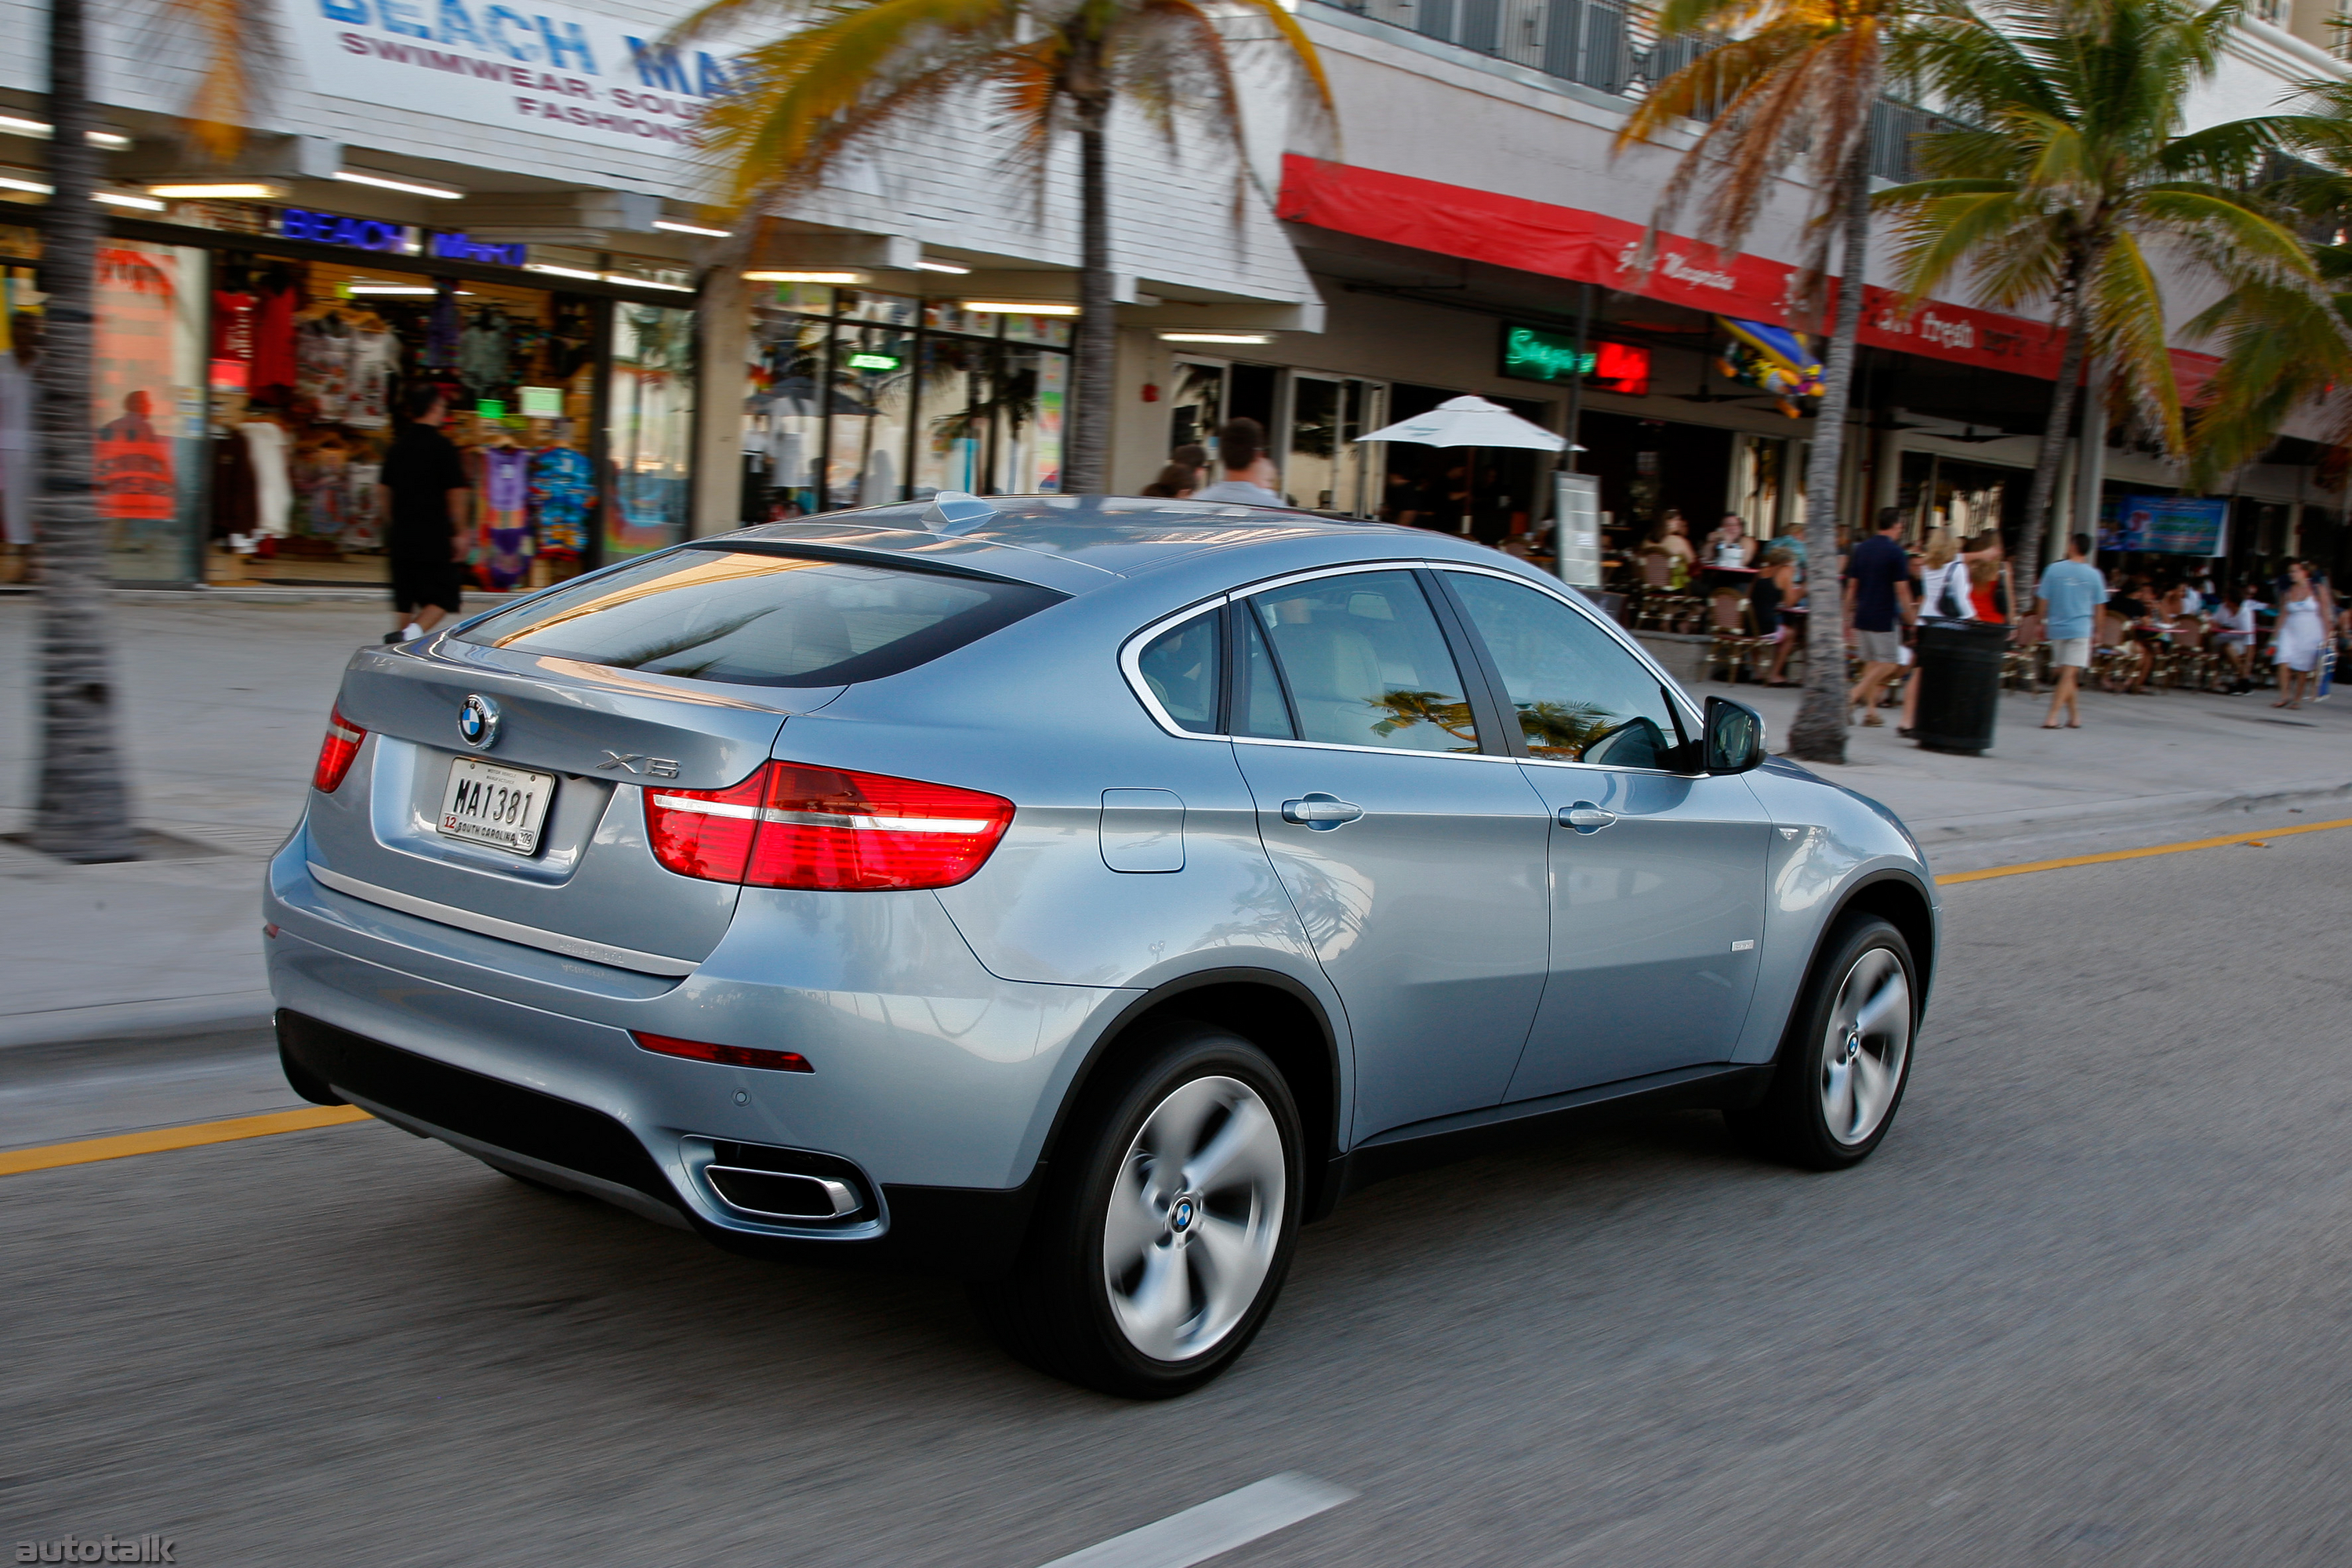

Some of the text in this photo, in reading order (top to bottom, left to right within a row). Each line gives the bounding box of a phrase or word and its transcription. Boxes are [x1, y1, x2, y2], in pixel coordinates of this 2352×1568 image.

[337, 31, 596, 101] SWIMWEAR
[595, 750, 682, 779] X6
[453, 779, 533, 827] MA1381
[445, 815, 457, 829] 12
[459, 822, 516, 843] SOUTH CAROLINA
